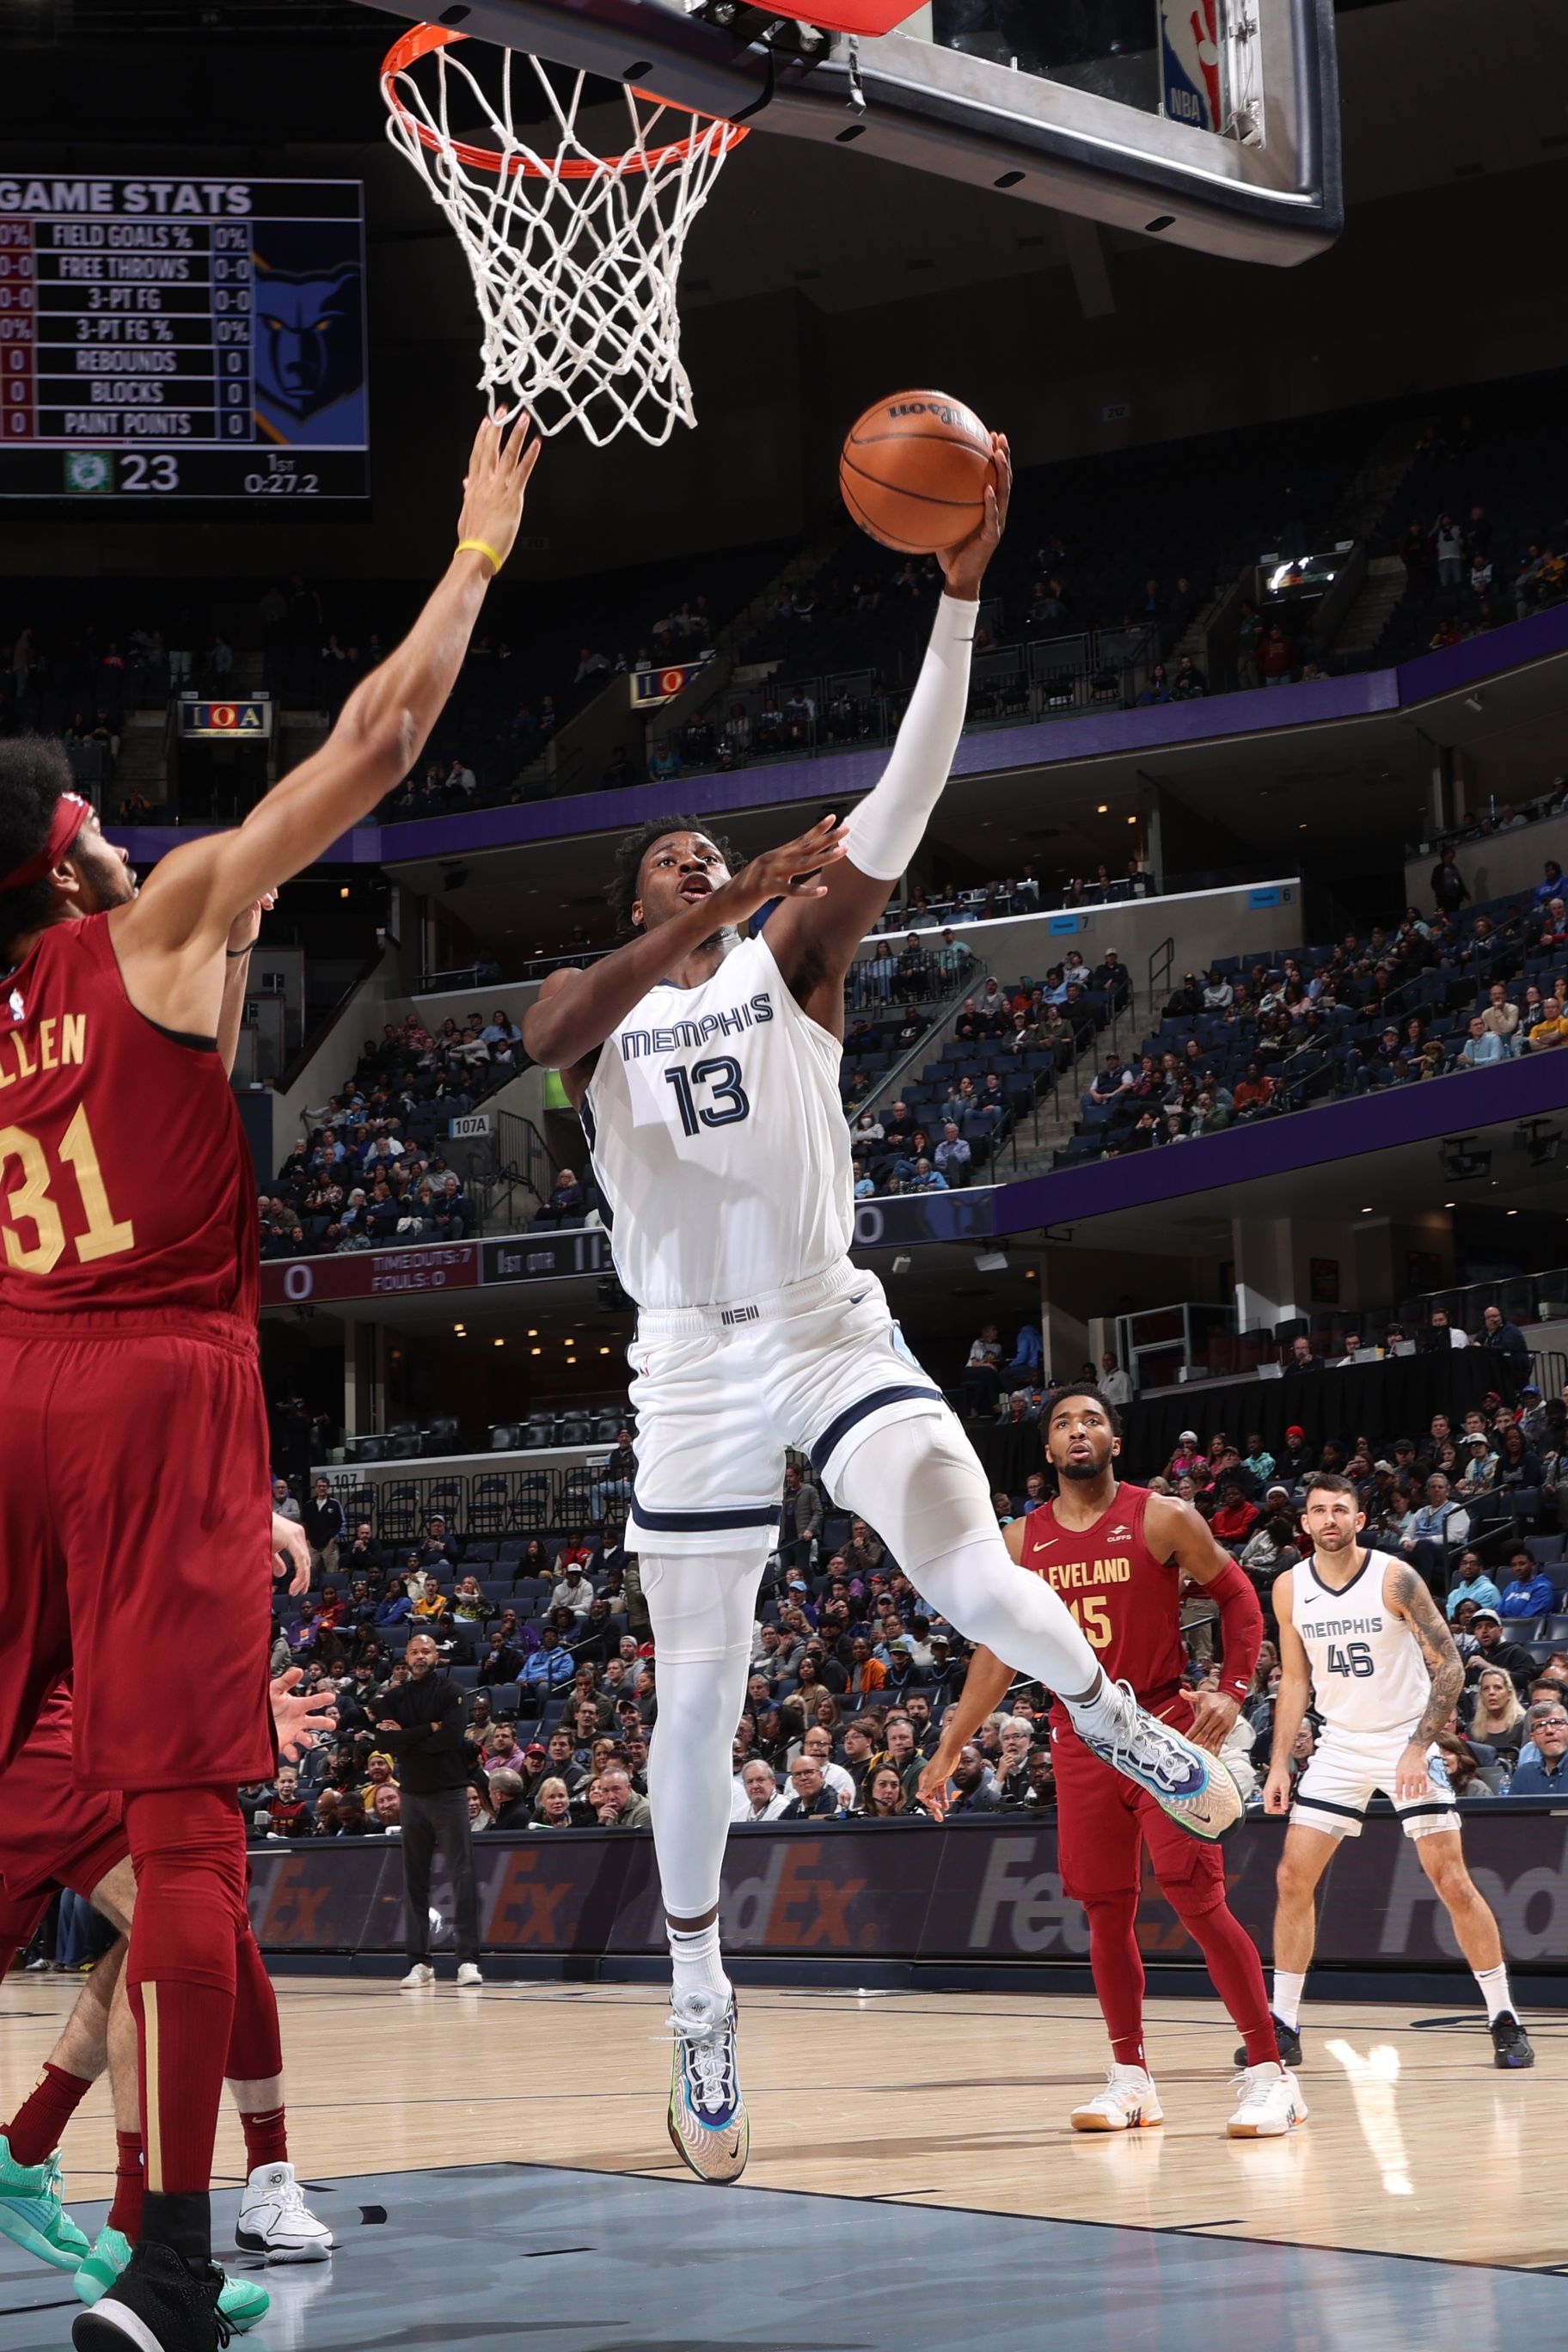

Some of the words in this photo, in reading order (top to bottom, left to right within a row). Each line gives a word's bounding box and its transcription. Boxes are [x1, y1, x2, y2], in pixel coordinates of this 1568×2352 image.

[1171, 88, 1202, 121] NBA
[0, 181, 113, 211] GAME
[122, 183, 253, 214] STATS
[0, 225, 28, 246] 0%
[52, 224, 105, 246] FIELD
[107, 225, 170, 247] GOALS
[172, 227, 193, 248] %
[216, 228, 248, 248] 0%
[59, 255, 107, 278] FREE
[107, 256, 189, 279] THROWS
[216, 258, 250, 279] 0-0
[88, 287, 135, 309] 3-PT
[138, 288, 162, 309] FG
[216, 290, 250, 310] 0-0
[1, 318, 31, 339] 0%
[76, 319, 123, 340] 3-PT
[125, 320, 150, 340] FG
[152, 321, 174, 341] %
[217, 322, 248, 342] 0%
[9, 350, 23, 370] 0
[76, 350, 177, 372] REBOUNDS
[227, 352, 242, 372] 0
[10, 381, 24, 401] 0
[90, 381, 164, 402] BLOCKS
[228, 383, 242, 403] 0
[11, 412, 26, 432] 0
[64, 413, 121, 434] PAINT
[124, 413, 191, 434] POINTS
[229, 414, 242, 434] 0
[120, 455, 180, 491] 23
[244, 474, 319, 493] 0:27.2
[644, 671, 701, 695] IO
[193, 706, 261, 726] IOA
[1283, 888, 1291, 902] 6
[1081, 916, 1090, 929] 7
[621, 993, 774, 1062] MEMPHIS
[664, 1055, 750, 1137] 13
[456, 1118, 487, 1134] 107A
[0, 1101, 135, 1276] 31
[284, 1264, 314, 1301] 0
[334, 1473, 358, 1490] 107
[1106, 1534, 1132, 1543] CLIFFS
[1032, 1557, 1131, 1591] EVELAND
[1302, 1617, 1383, 1639] MEMPHIS
[1326, 1642, 1375, 1678] 46
